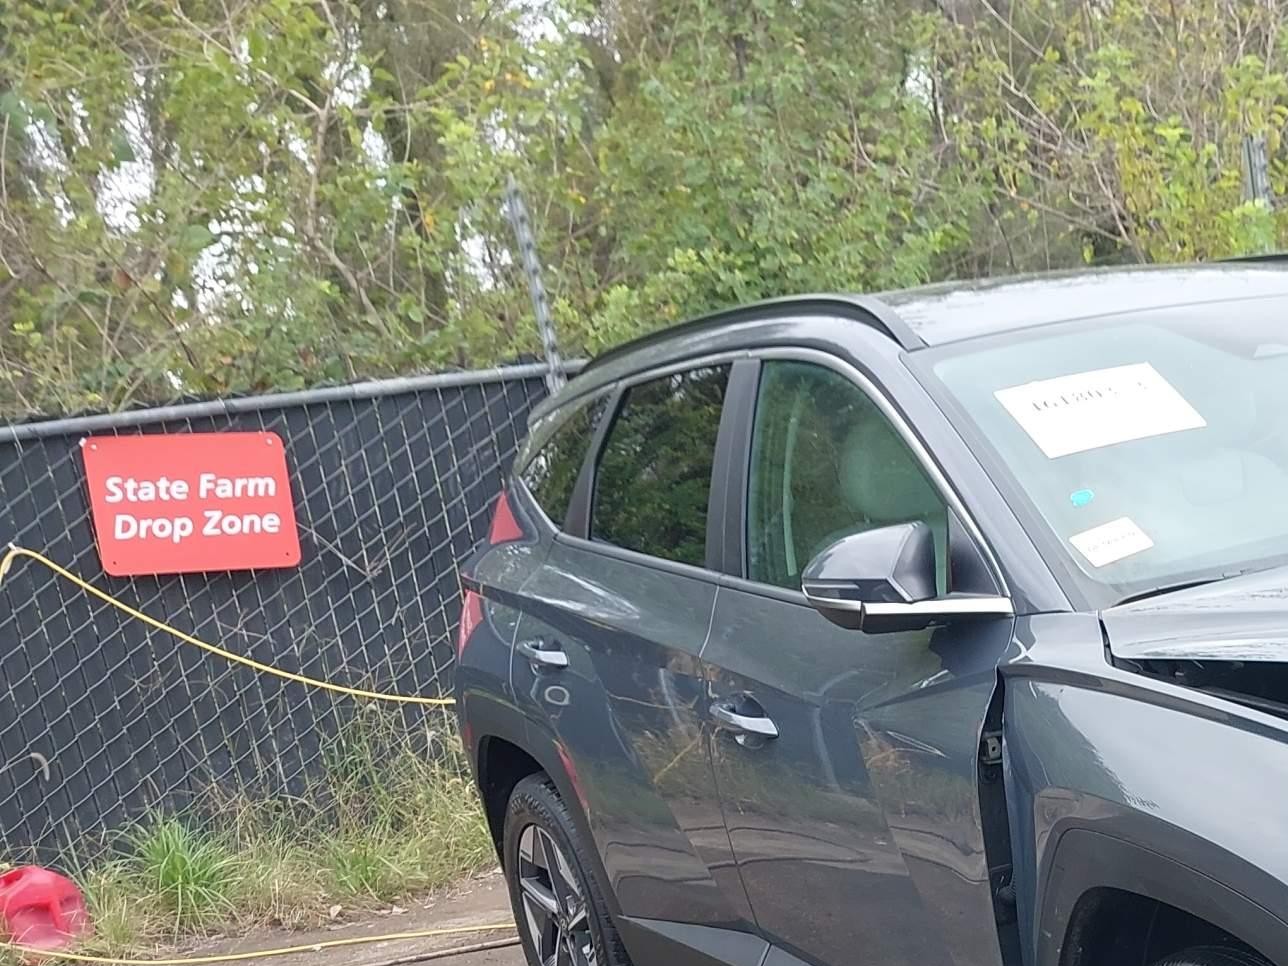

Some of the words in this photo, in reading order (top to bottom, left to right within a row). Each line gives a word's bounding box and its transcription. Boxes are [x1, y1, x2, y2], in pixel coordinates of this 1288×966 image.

[104, 476, 189, 503] State
[199, 473, 276, 499] Farm
[114, 513, 194, 543] Drop
[202, 510, 281, 536] Zone
